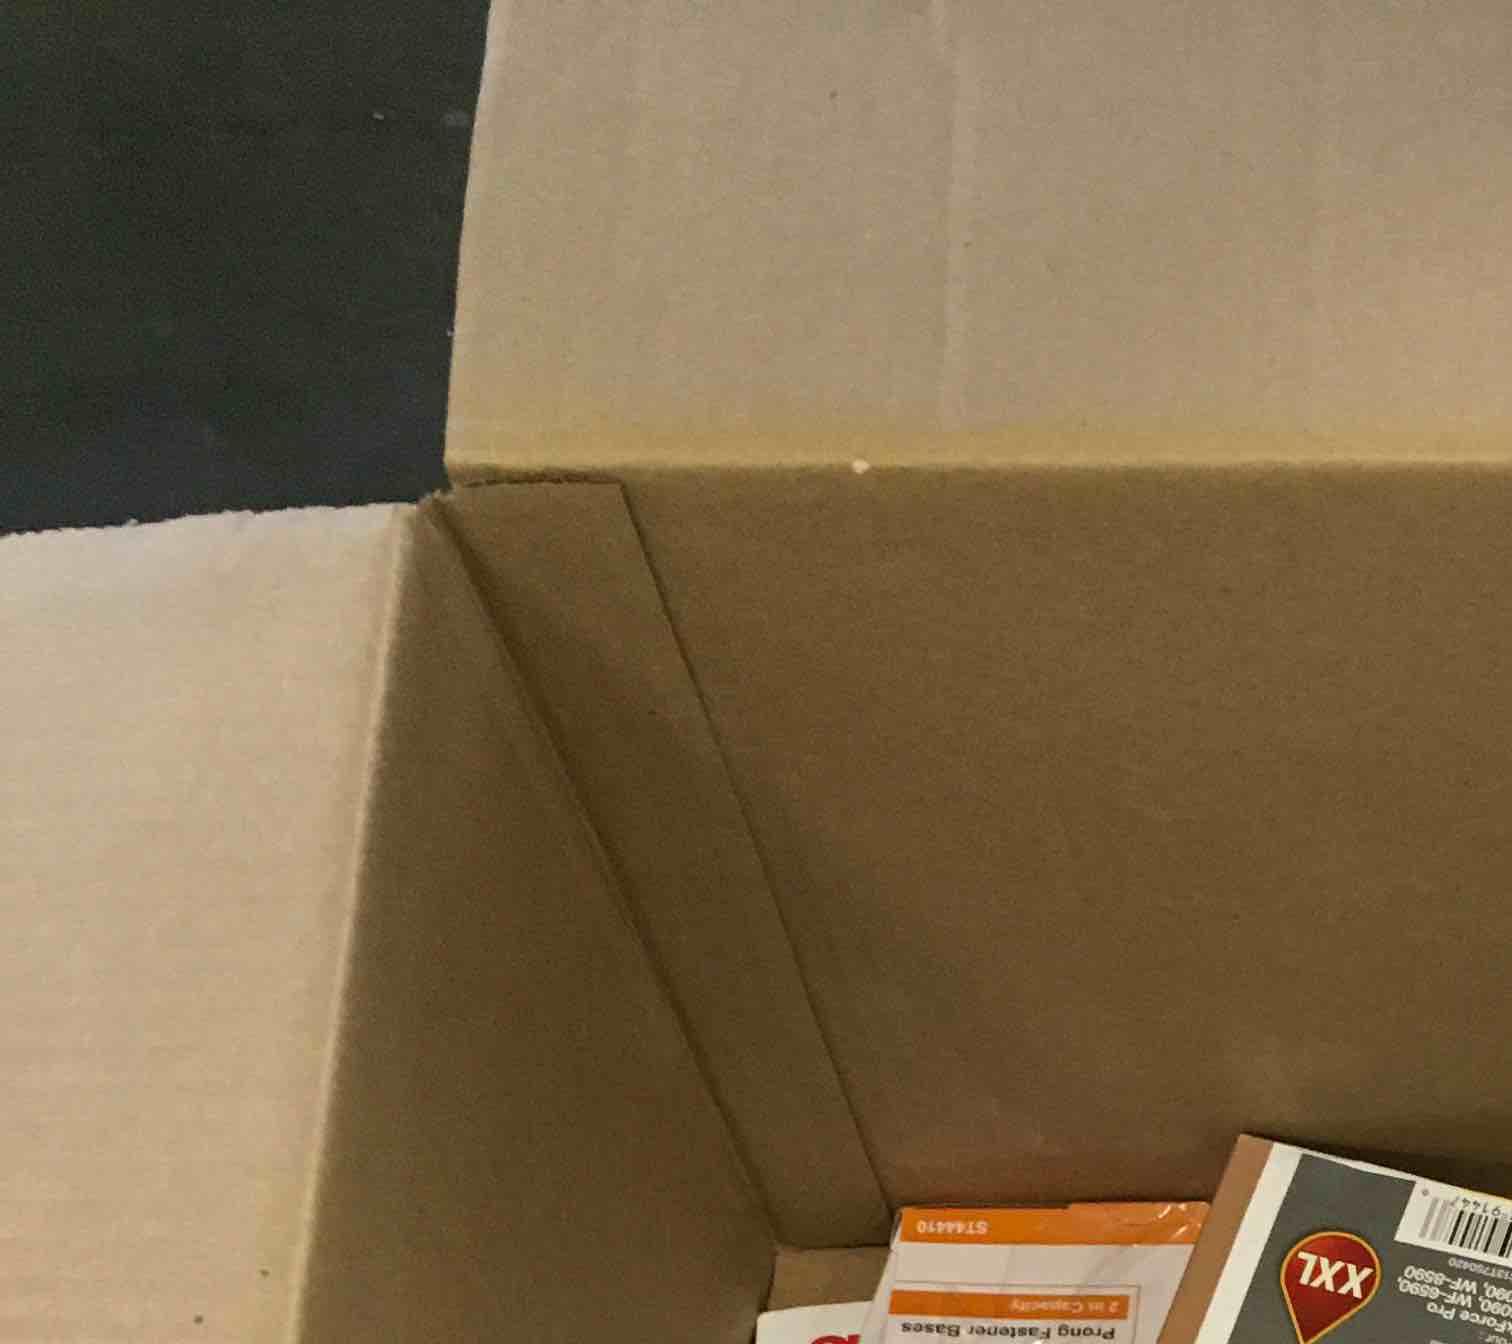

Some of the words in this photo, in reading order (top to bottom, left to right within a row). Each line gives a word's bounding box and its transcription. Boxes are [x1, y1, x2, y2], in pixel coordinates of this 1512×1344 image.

[1297, 1251, 1375, 1301] XXL
[1426, 1302, 1456, 1321] Pro
[901, 1322, 960, 1337] Bases
[968, 1324, 1051, 1340] Fastener
[1058, 1324, 1116, 1340] Prong
